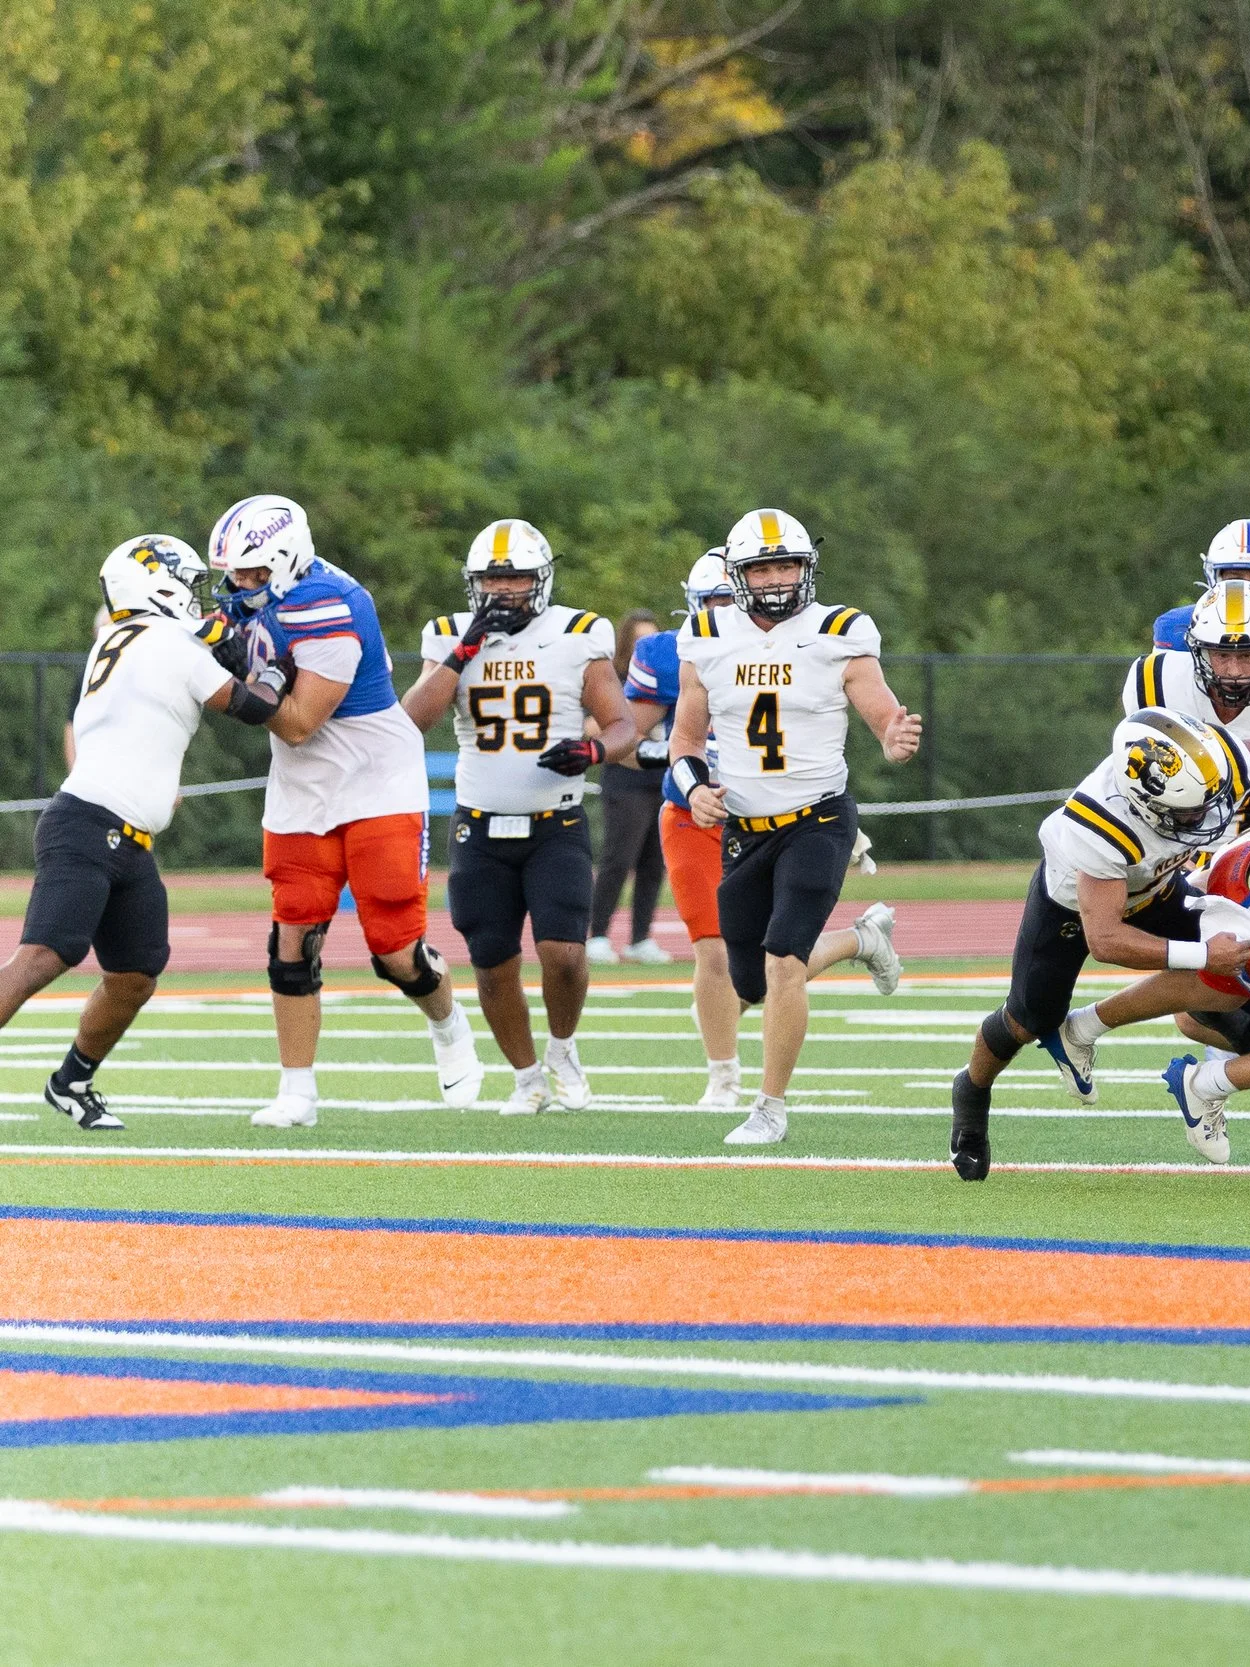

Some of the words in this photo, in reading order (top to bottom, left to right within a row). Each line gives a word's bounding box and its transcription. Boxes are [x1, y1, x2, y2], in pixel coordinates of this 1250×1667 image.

[84, 623, 149, 698] 8
[483, 661, 536, 681] NEERS
[735, 663, 792, 686] NEERS
[468, 683, 552, 753] 59
[746, 691, 787, 773] 4
